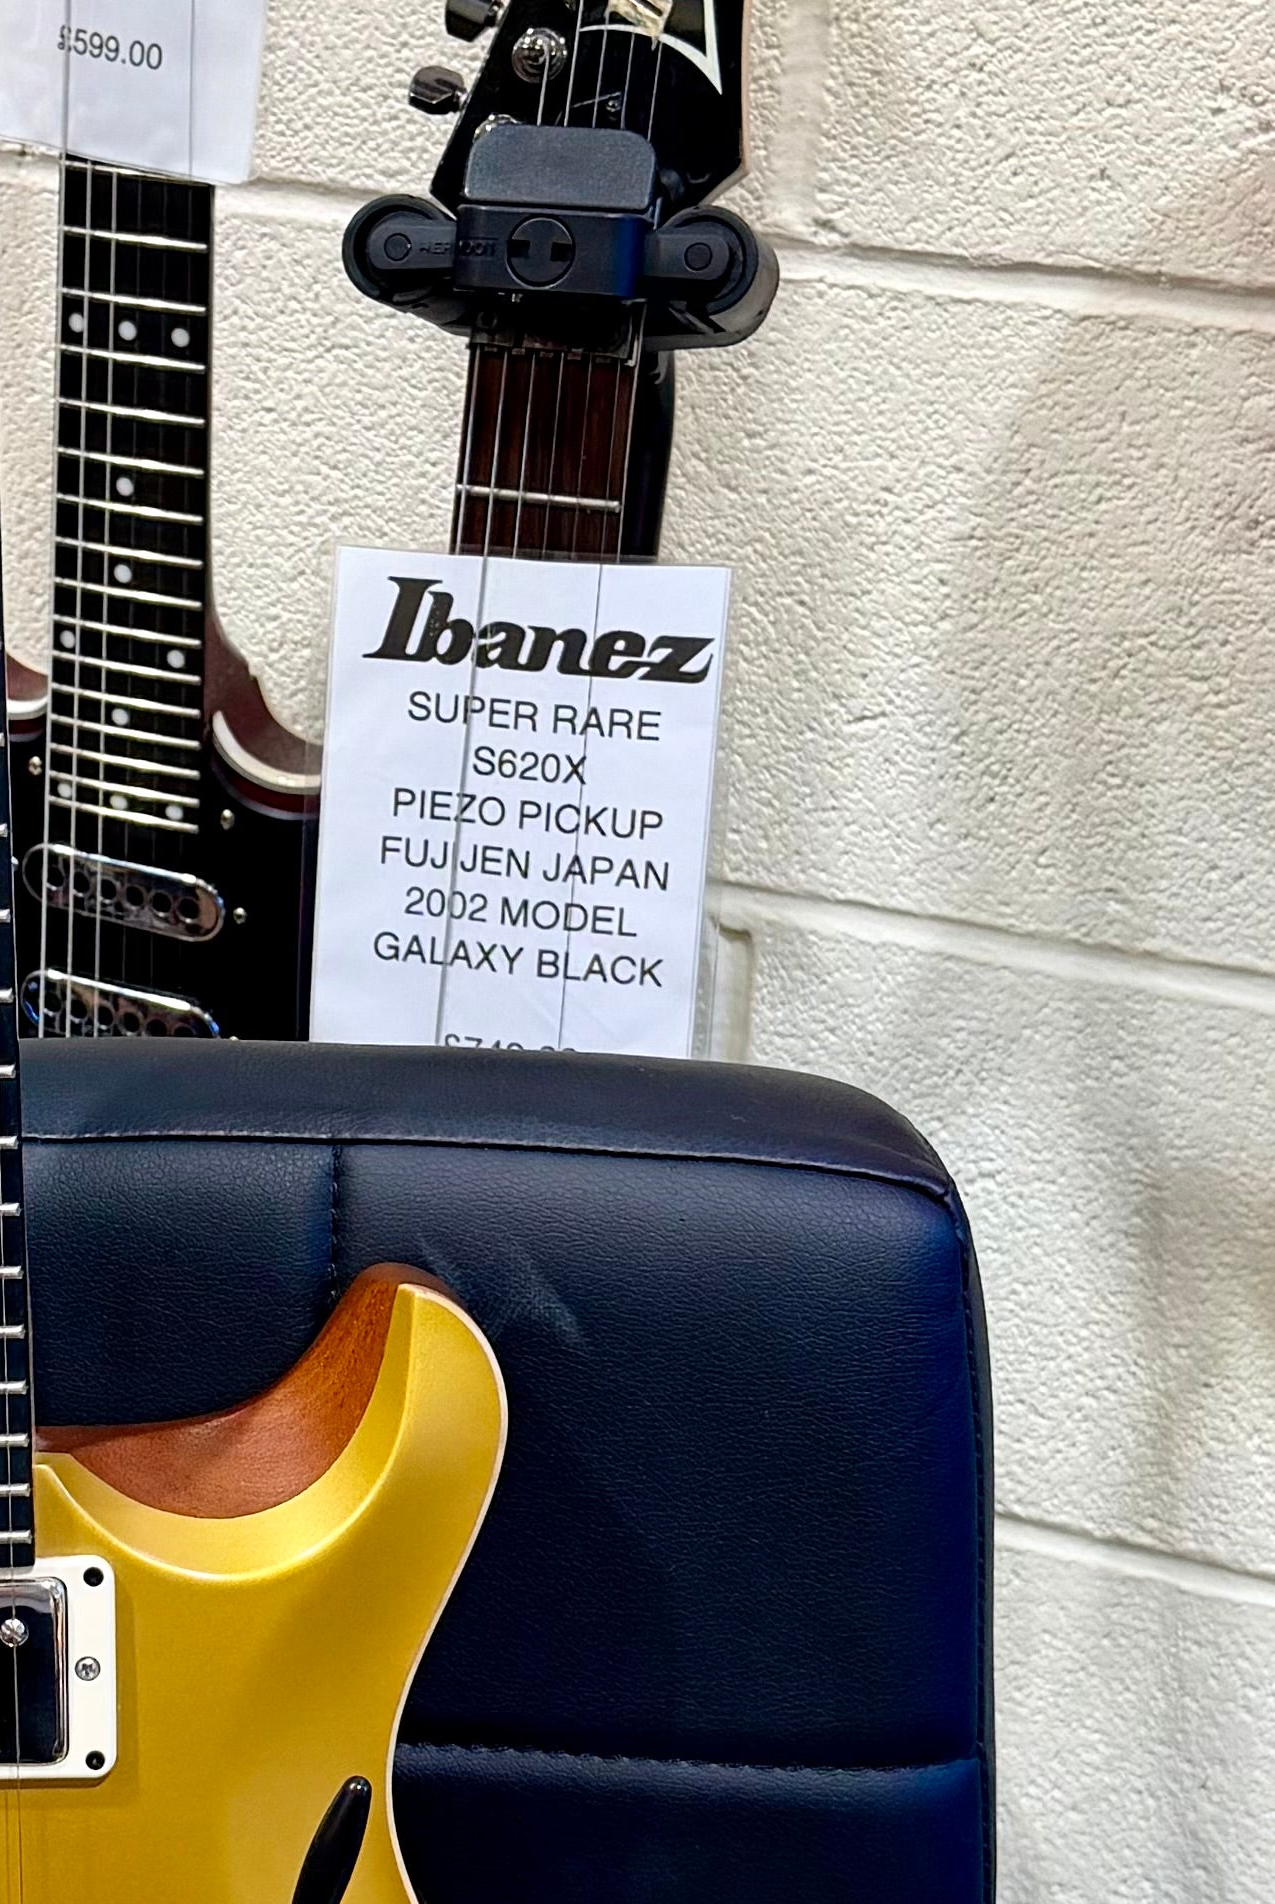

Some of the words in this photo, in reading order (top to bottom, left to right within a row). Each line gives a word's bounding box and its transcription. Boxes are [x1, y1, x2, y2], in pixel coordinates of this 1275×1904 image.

[57, 25, 163, 70] £599.00
[362, 575, 715, 684] Ibanez
[408, 691, 538, 732] SUPER
[553, 704, 662, 742] RARE
[472, 747, 587, 785] S620X
[392, 787, 506, 826] PIEZO
[518, 799, 664, 840] PICKUP
[381, 836, 530, 879] FUJJEN
[543, 853, 669, 891] JAPAN
[404, 886, 488, 923] 2002
[500, 897, 637, 938] MODEL
[374, 931, 524, 975] GALAXY
[536, 949, 664, 988] BLACK
